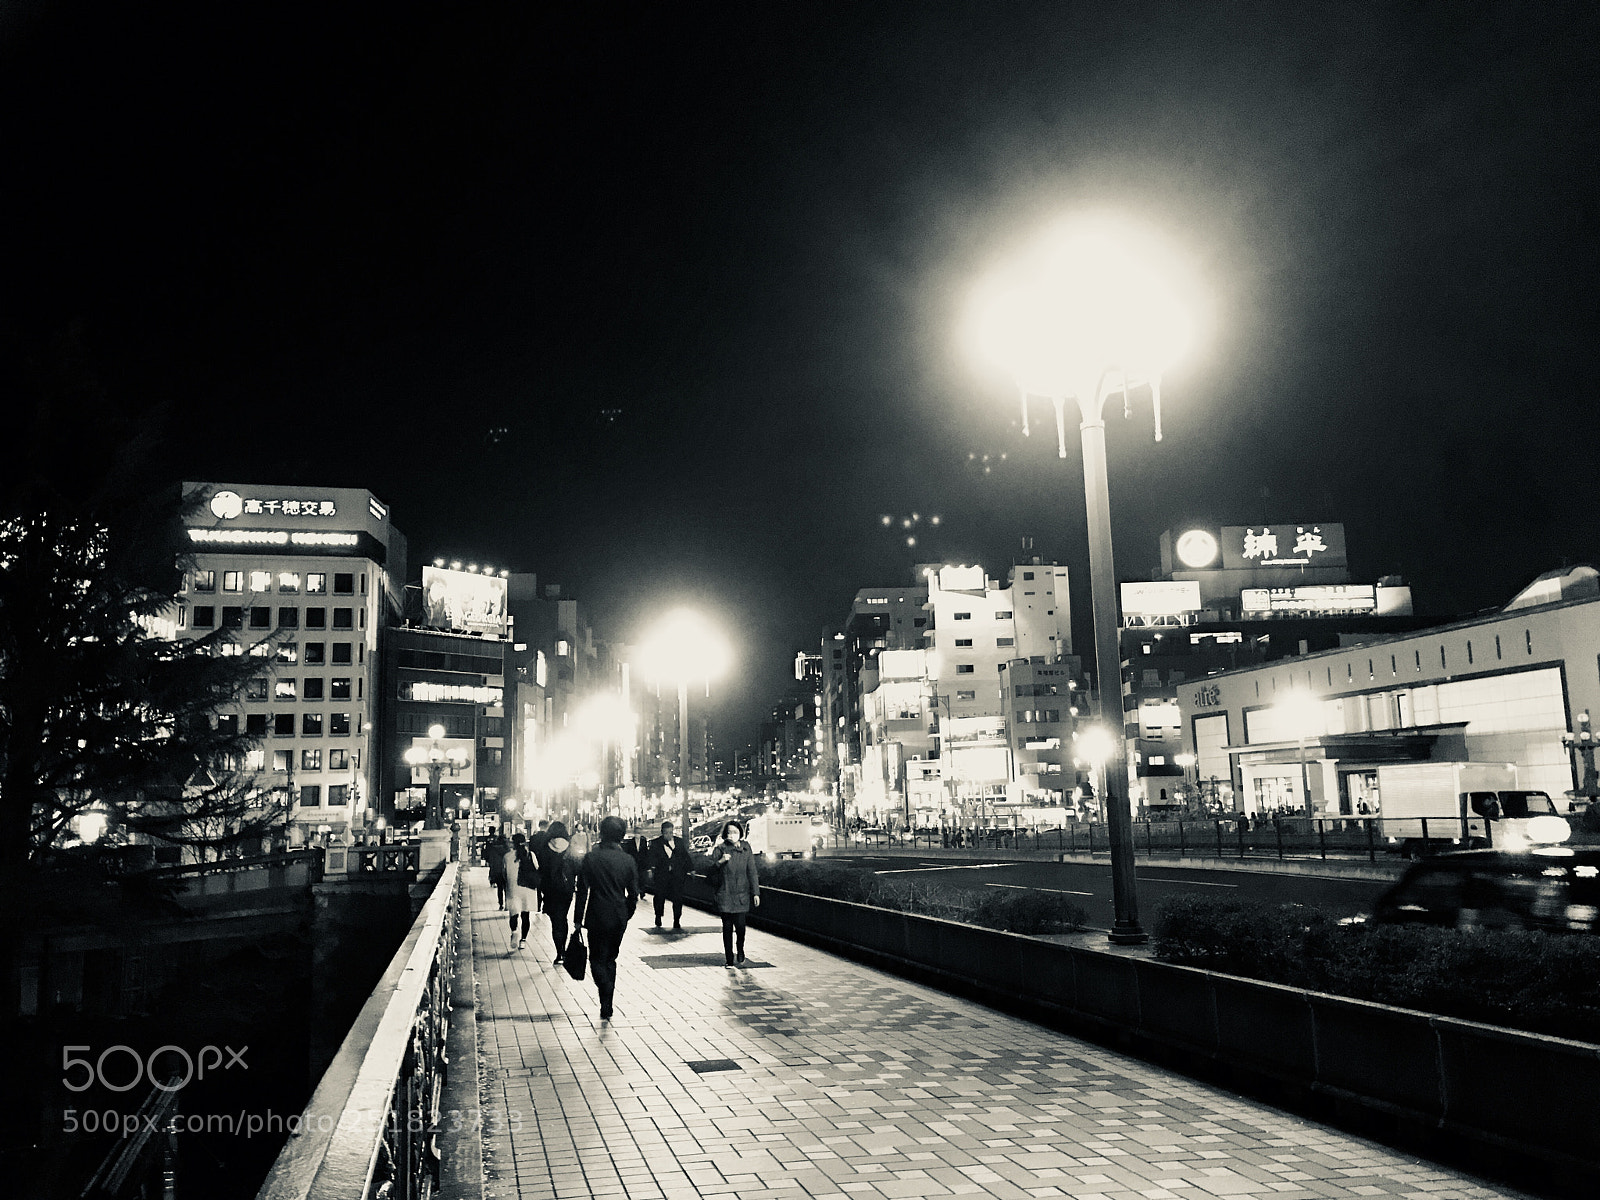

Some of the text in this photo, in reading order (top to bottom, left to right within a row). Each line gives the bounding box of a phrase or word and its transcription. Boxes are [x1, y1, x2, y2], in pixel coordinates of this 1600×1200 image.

[244, 498, 337, 517] 高千穂交易
